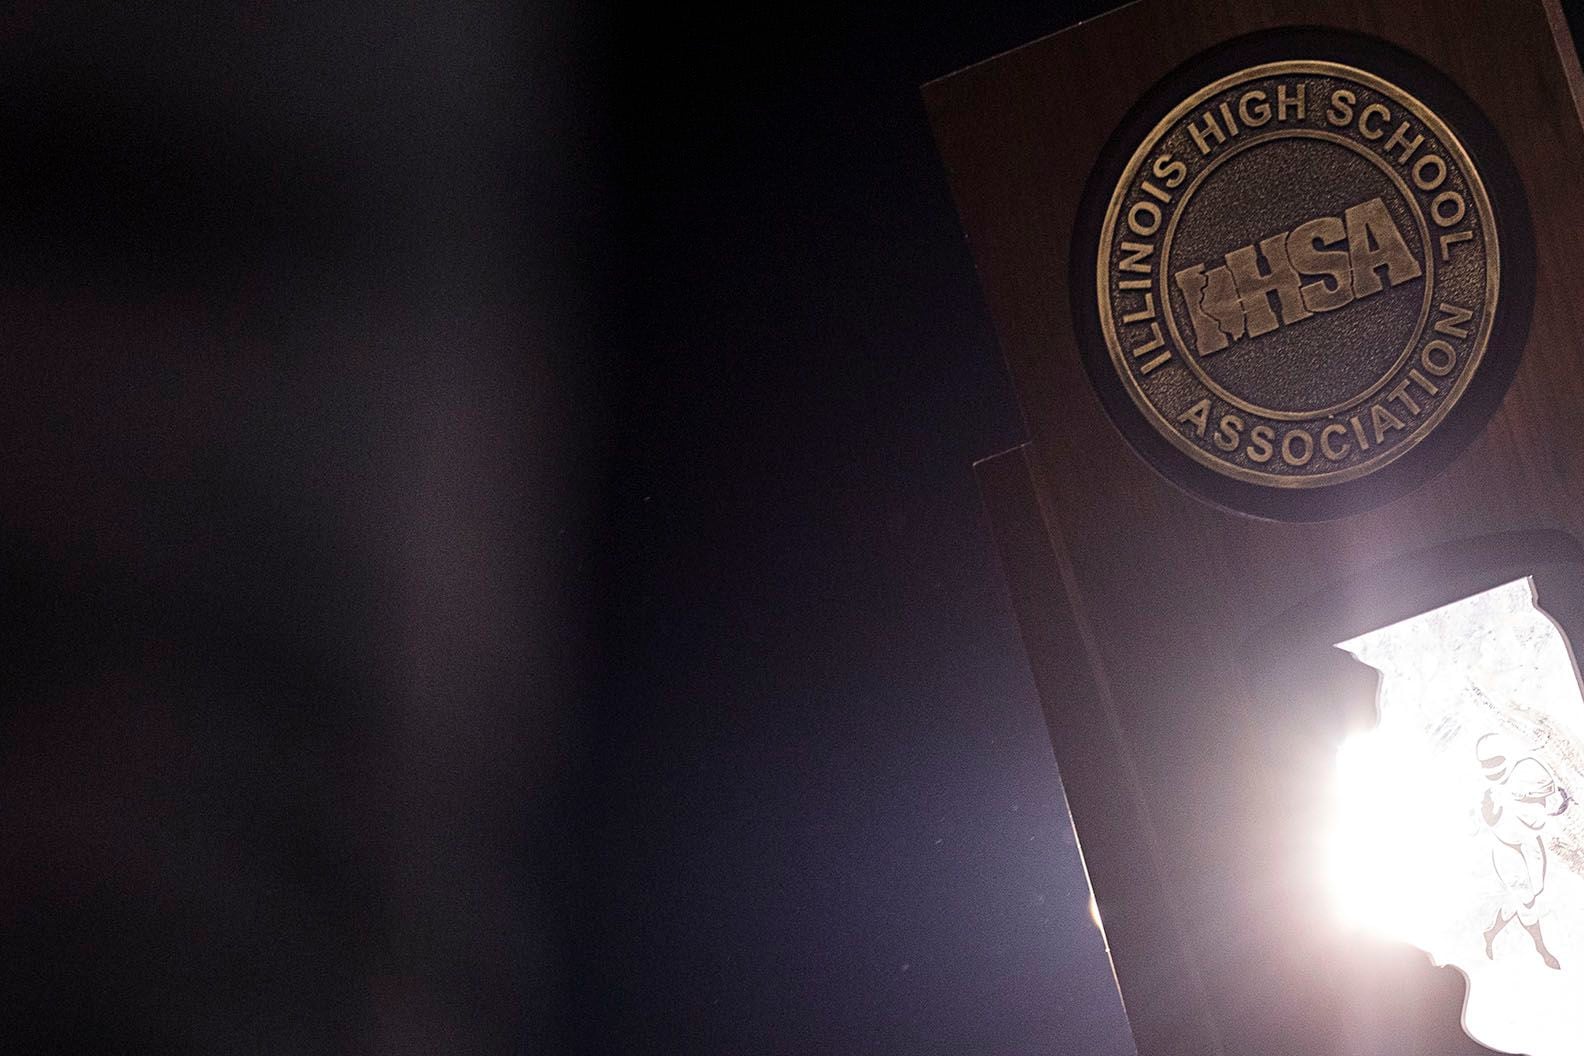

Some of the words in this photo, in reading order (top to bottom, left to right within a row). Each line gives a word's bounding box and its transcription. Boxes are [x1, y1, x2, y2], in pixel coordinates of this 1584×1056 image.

[1118, 153, 1188, 376] ILLINOIS
[1187, 84, 1307, 155] HIGH
[1326, 89, 1474, 261] SCHOOL
[1175, 197, 1423, 357] IHSA
[1179, 302, 1474, 466] ASSOCIATION
